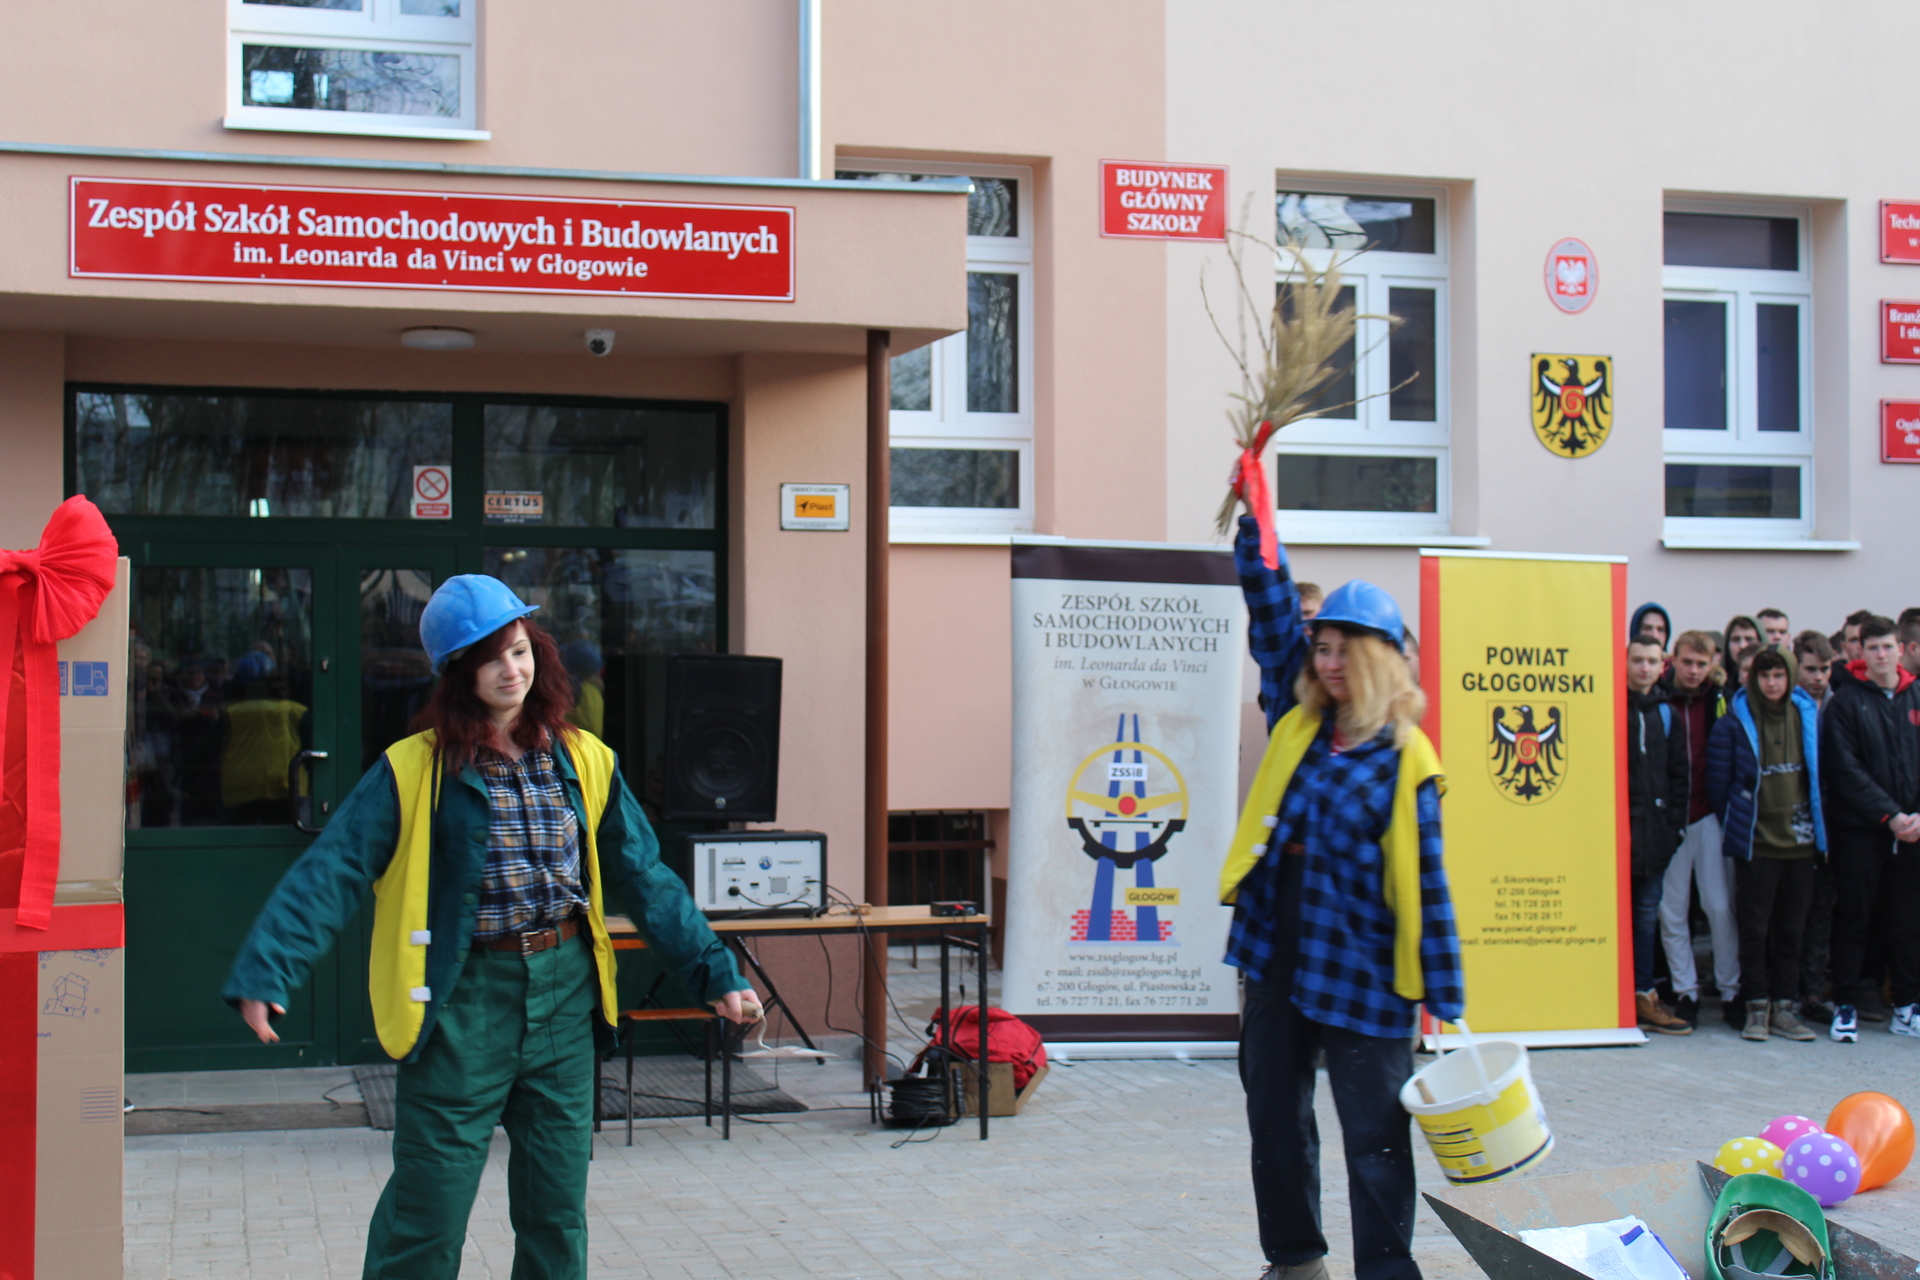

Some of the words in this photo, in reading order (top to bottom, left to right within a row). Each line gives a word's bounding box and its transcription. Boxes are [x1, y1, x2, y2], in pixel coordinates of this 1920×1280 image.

[1116, 168, 1213, 190] BUDYNEK
[1120, 188, 1209, 211] GŁÓWNY
[88, 198, 197, 237] Zespół
[204, 203, 290, 235] Szkół
[298, 207, 555, 251] Samochodowych
[563, 218, 574, 246] i
[581, 219, 779, 260] Budowlanych
[1127, 212, 1202, 233] SZKOŁY
[233, 242, 273, 264] im.
[279, 243, 398, 268] Leonarda
[407, 248, 437, 270] da
[442, 249, 505, 272] Vinci
[510, 254, 532, 273] w
[537, 253, 648, 281] Głogowie
[488, 497, 539, 507] CERTUS
[1061, 593, 1135, 611] ZESPÓŁ
[1140, 595, 1203, 613] SZKÓŁ
[1033, 612, 1230, 633] SAMOCHODOWYCH
[1044, 632, 1050, 647] I
[1057, 633, 1218, 652] BUDOWLANYCH
[1053, 656, 1075, 670] im.
[1081, 657, 1145, 672] Leonarda
[1150, 658, 1167, 672] da
[1172, 659, 1208, 673] Vinci
[1486, 646, 1569, 666] POWIAT
[1099, 676, 1178, 691] GŁOGOWIE
[1462, 672, 1594, 693] GŁOGOWSKI
[1111, 767, 1143, 777] ZSSiB
[1056, 982, 1076, 991] 200
